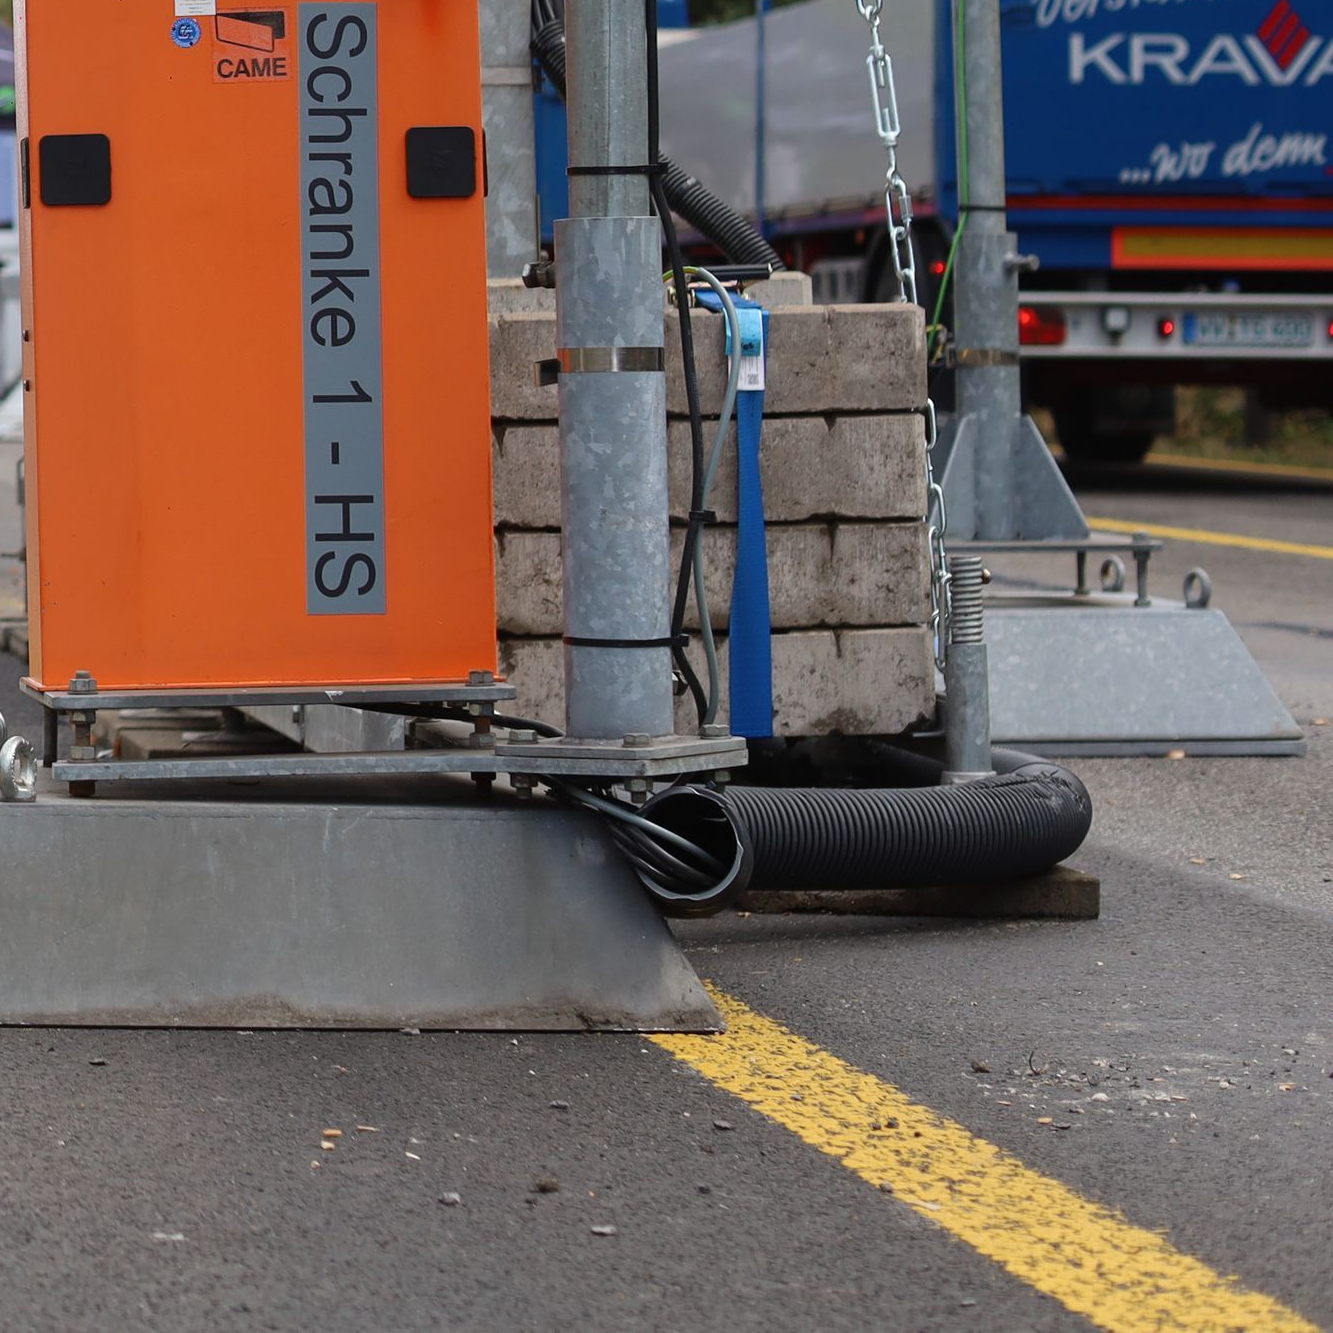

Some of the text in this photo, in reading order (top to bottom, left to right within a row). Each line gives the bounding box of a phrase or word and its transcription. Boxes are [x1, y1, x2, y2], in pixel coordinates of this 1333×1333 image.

[217, 58, 287, 78] CAME
[305, 12, 370, 348] Schranke
[312, 381, 373, 404] 1
[314, 493, 377, 598] HS
